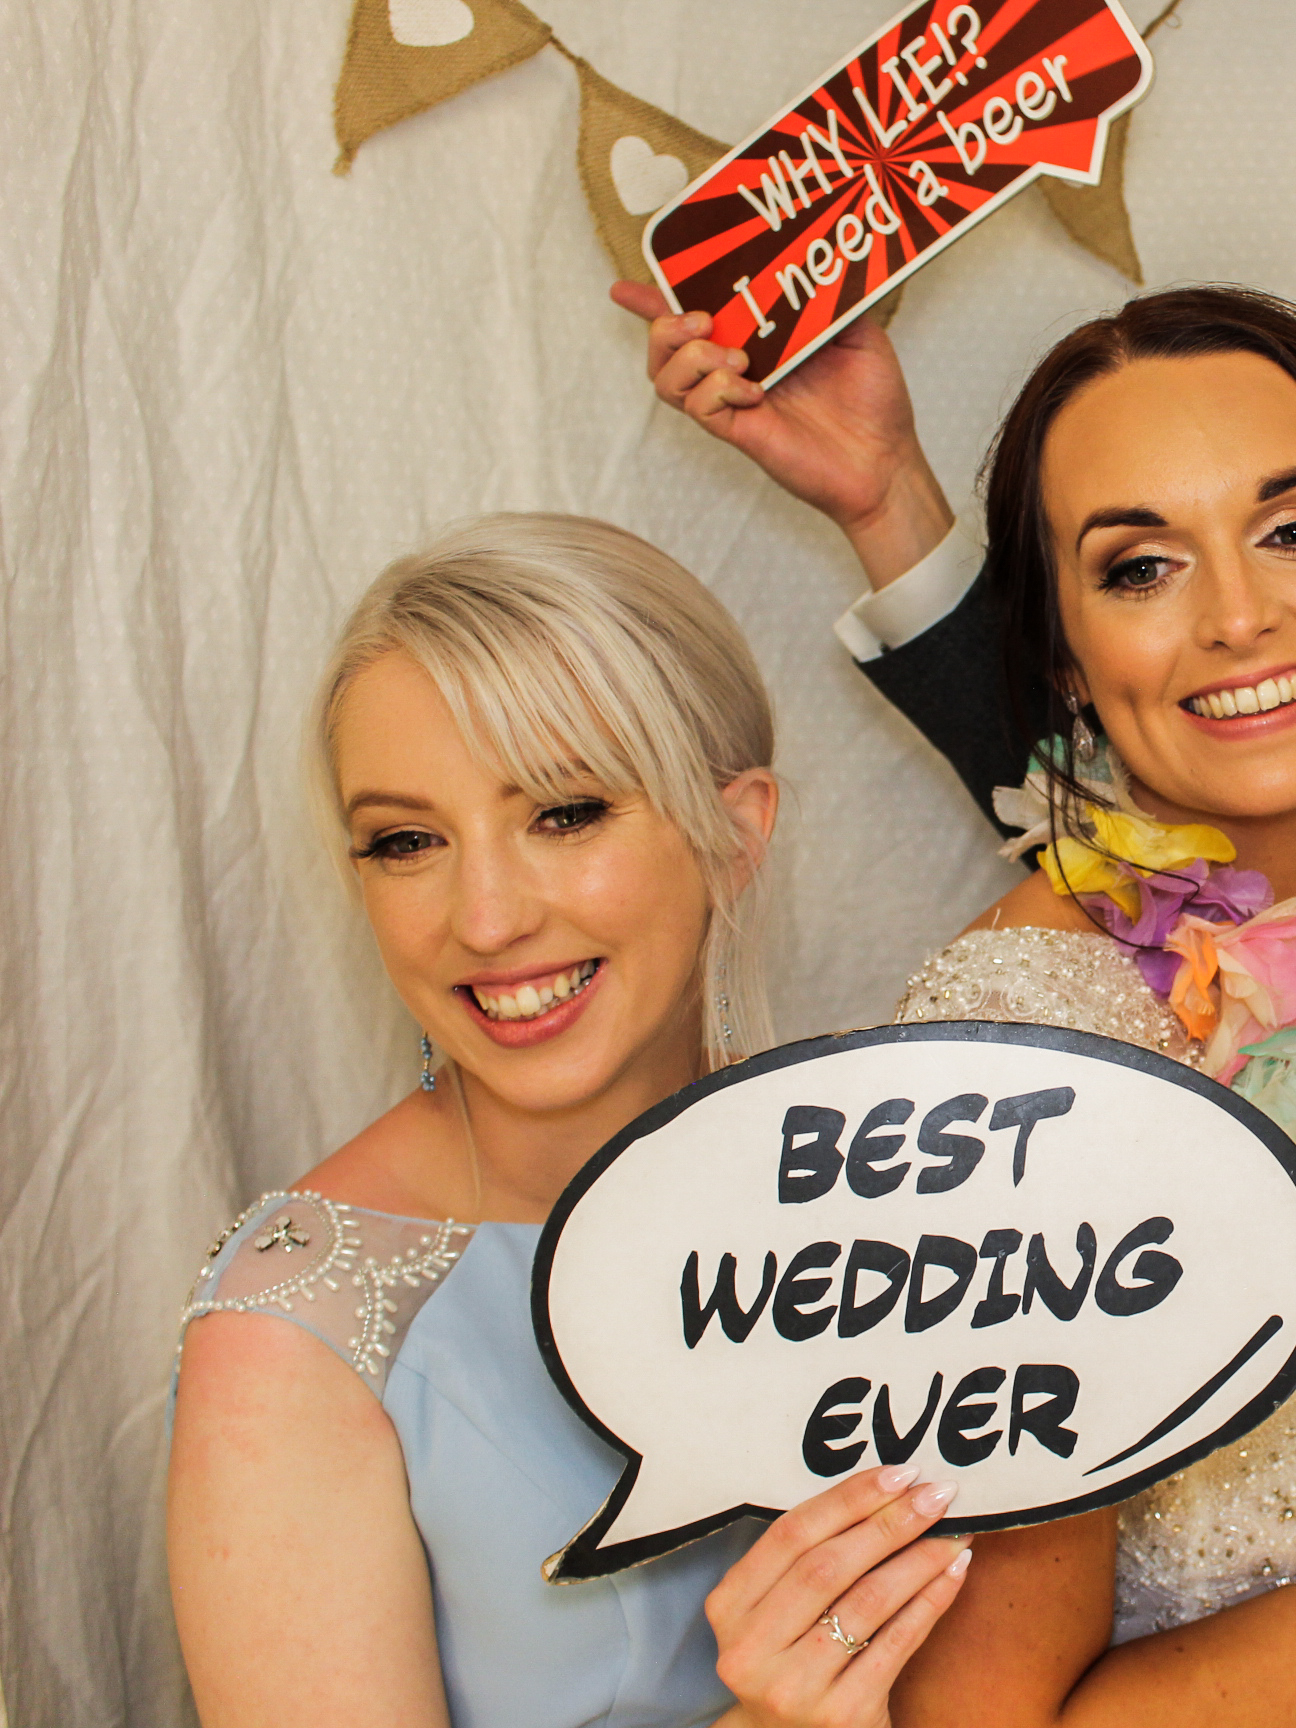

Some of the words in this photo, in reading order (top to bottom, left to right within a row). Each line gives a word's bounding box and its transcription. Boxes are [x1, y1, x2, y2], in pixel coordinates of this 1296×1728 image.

[737, 109, 855, 232] WHY
[853, 4, 988, 149] LIE!?
[733, 276, 776, 338] I
[774, 163, 901, 311] need
[908, 159, 949, 206] a
[937, 54, 1073, 175] beer
[778, 1086, 1076, 1204] BEST
[680, 1216, 1184, 1349] WEDDING
[802, 1364, 1080, 1477] EVER
